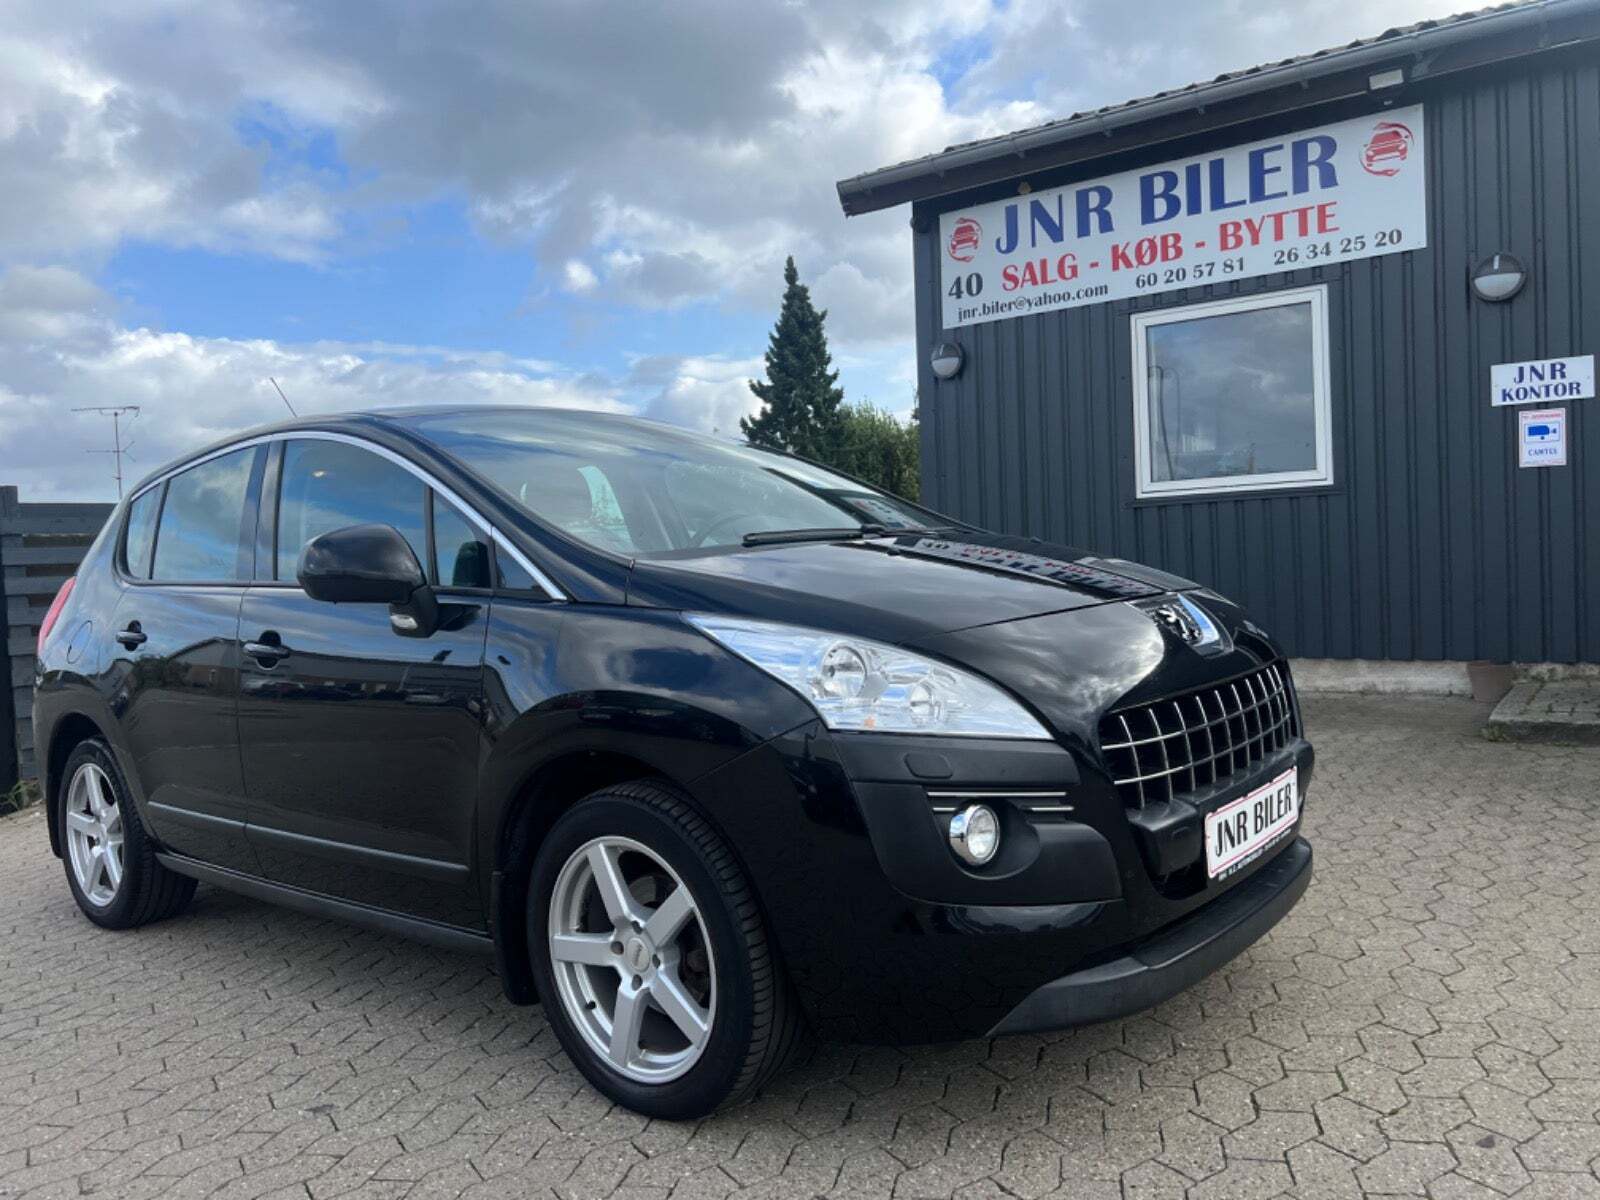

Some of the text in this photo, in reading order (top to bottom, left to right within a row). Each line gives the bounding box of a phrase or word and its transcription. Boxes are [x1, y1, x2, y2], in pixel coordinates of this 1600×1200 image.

[995, 134, 1339, 254] JNR BILER
[1002, 253, 1078, 292] SALG
[1111, 232, 1183, 272] KØB
[1219, 201, 1340, 252] BYTTE
[1274, 228, 1402, 265] 26 34 25 20
[948, 272, 983, 299] 40
[1136, 257, 1244, 289] 60 20 57 81
[958, 284, 1108, 322] jnr.biler@yahoo.com
[1501, 381, 1581, 402] KONTOR
[1514, 362, 1567, 384] JNR
[1215, 810, 1248, 857] JNR
[1253, 783, 1292, 835] BILER
